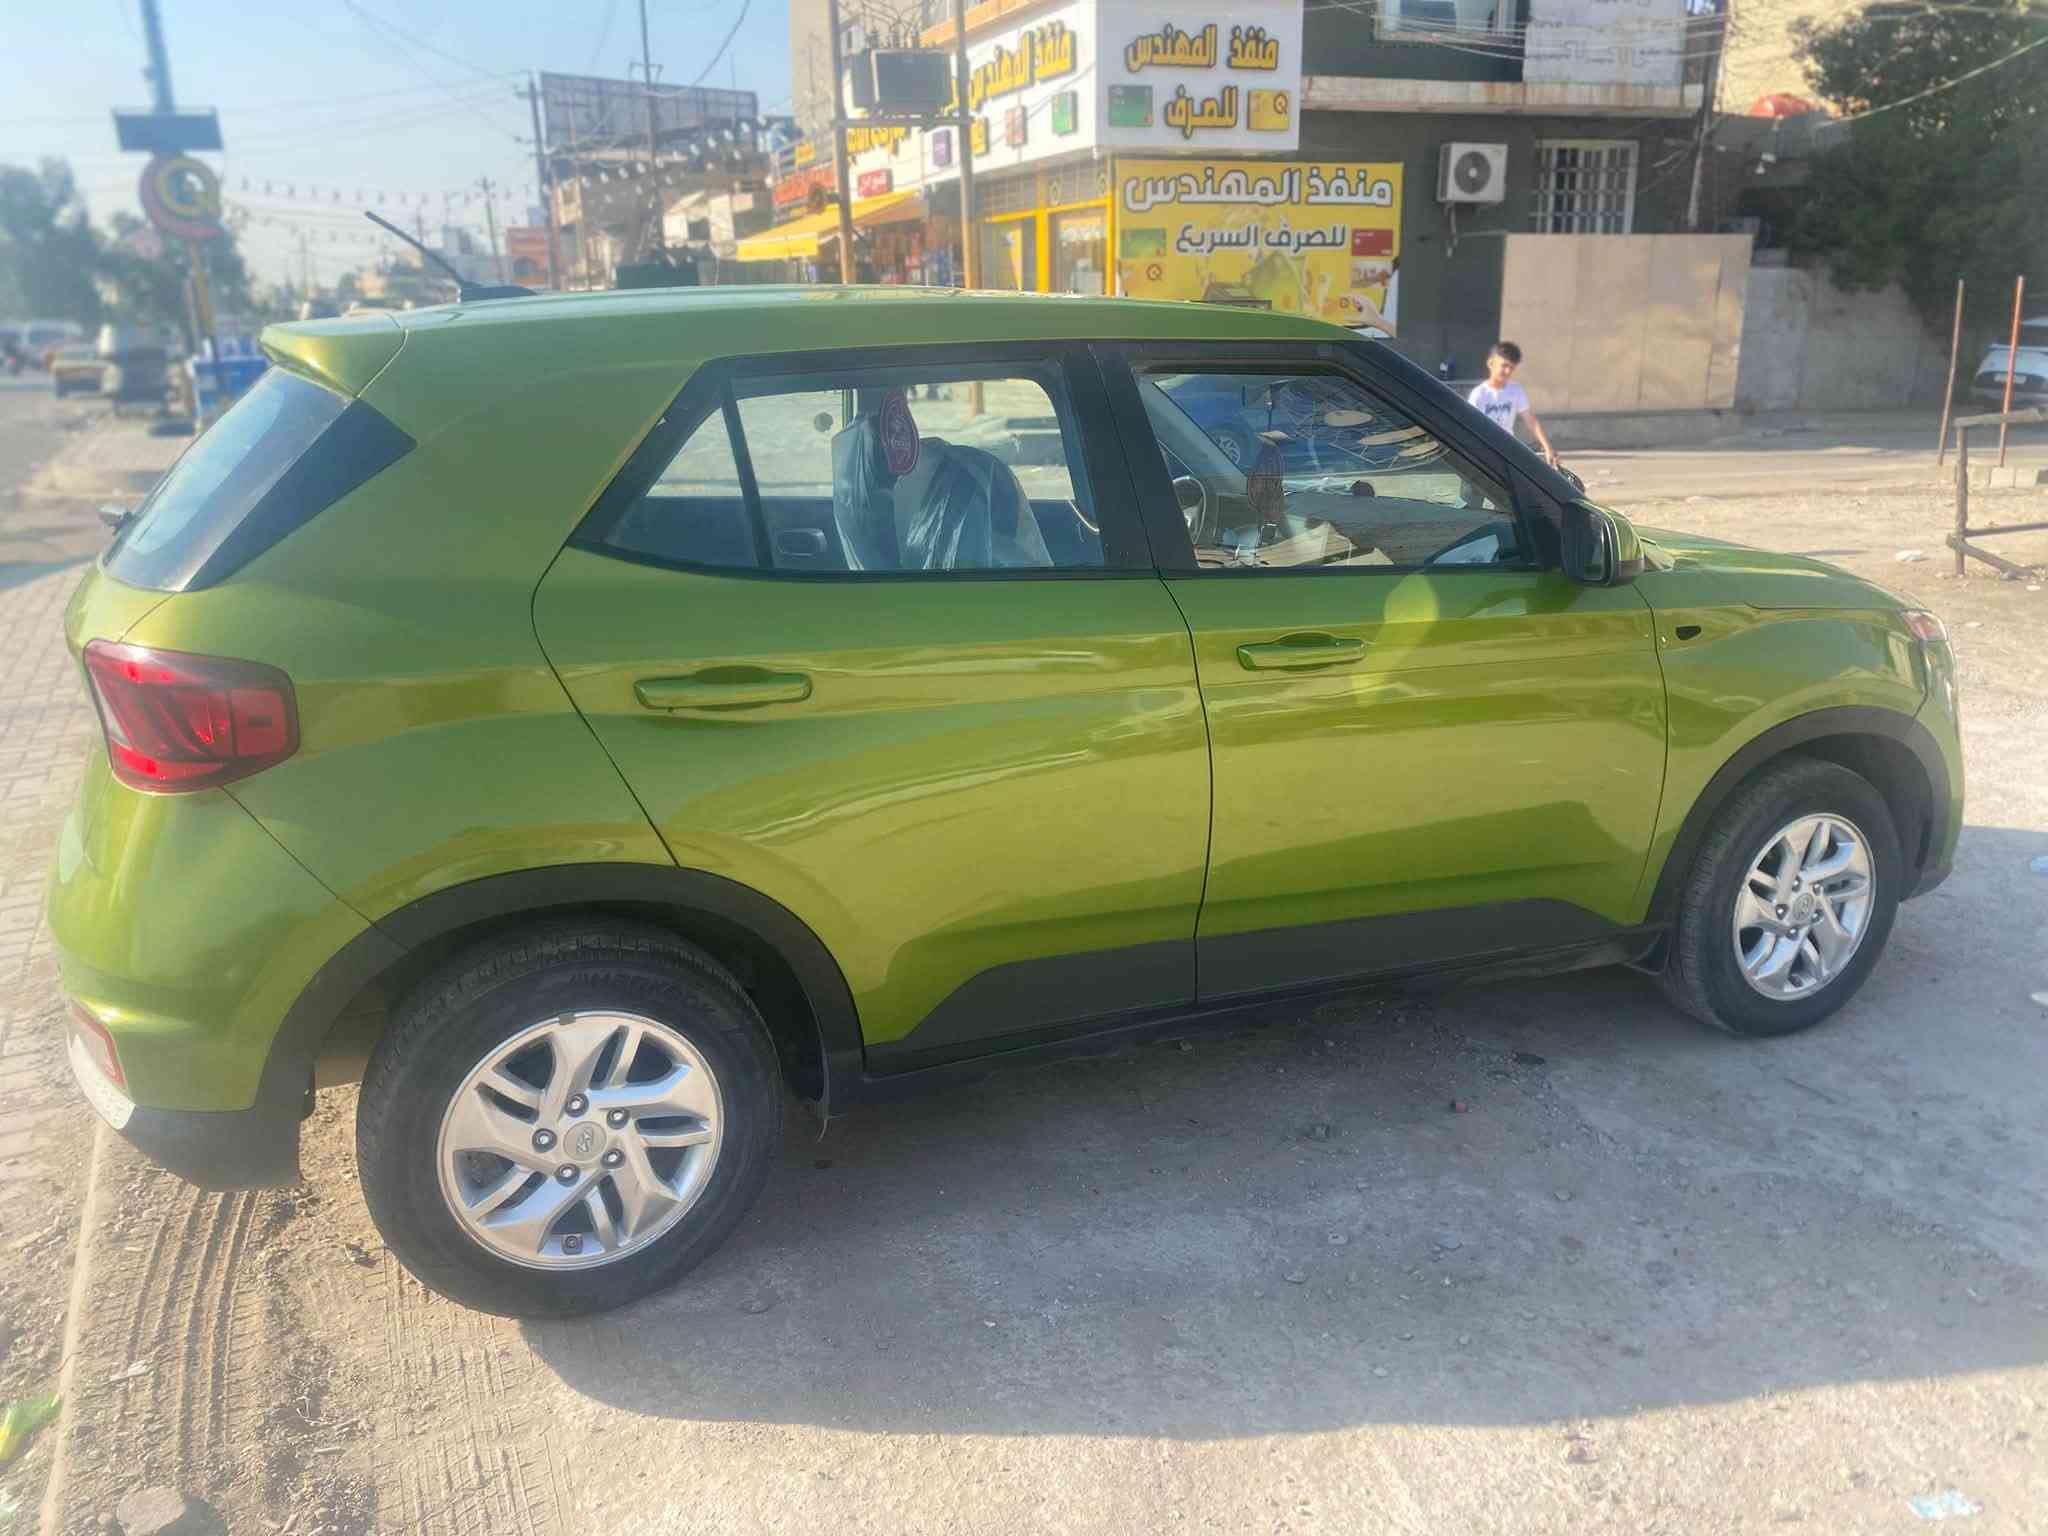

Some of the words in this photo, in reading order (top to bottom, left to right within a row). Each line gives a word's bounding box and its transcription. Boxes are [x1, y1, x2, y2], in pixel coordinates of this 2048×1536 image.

[1125, 22, 1217, 73] المهندس
[1227, 24, 1279, 70] منفذ
[1165, 83, 1238, 139] للصرف
[1124, 166, 1302, 212] المهندس
[1305, 166, 1393, 206] منفذ
[1176, 222, 1259, 253] السريع
[1264, 222, 1346, 254] للصرف
